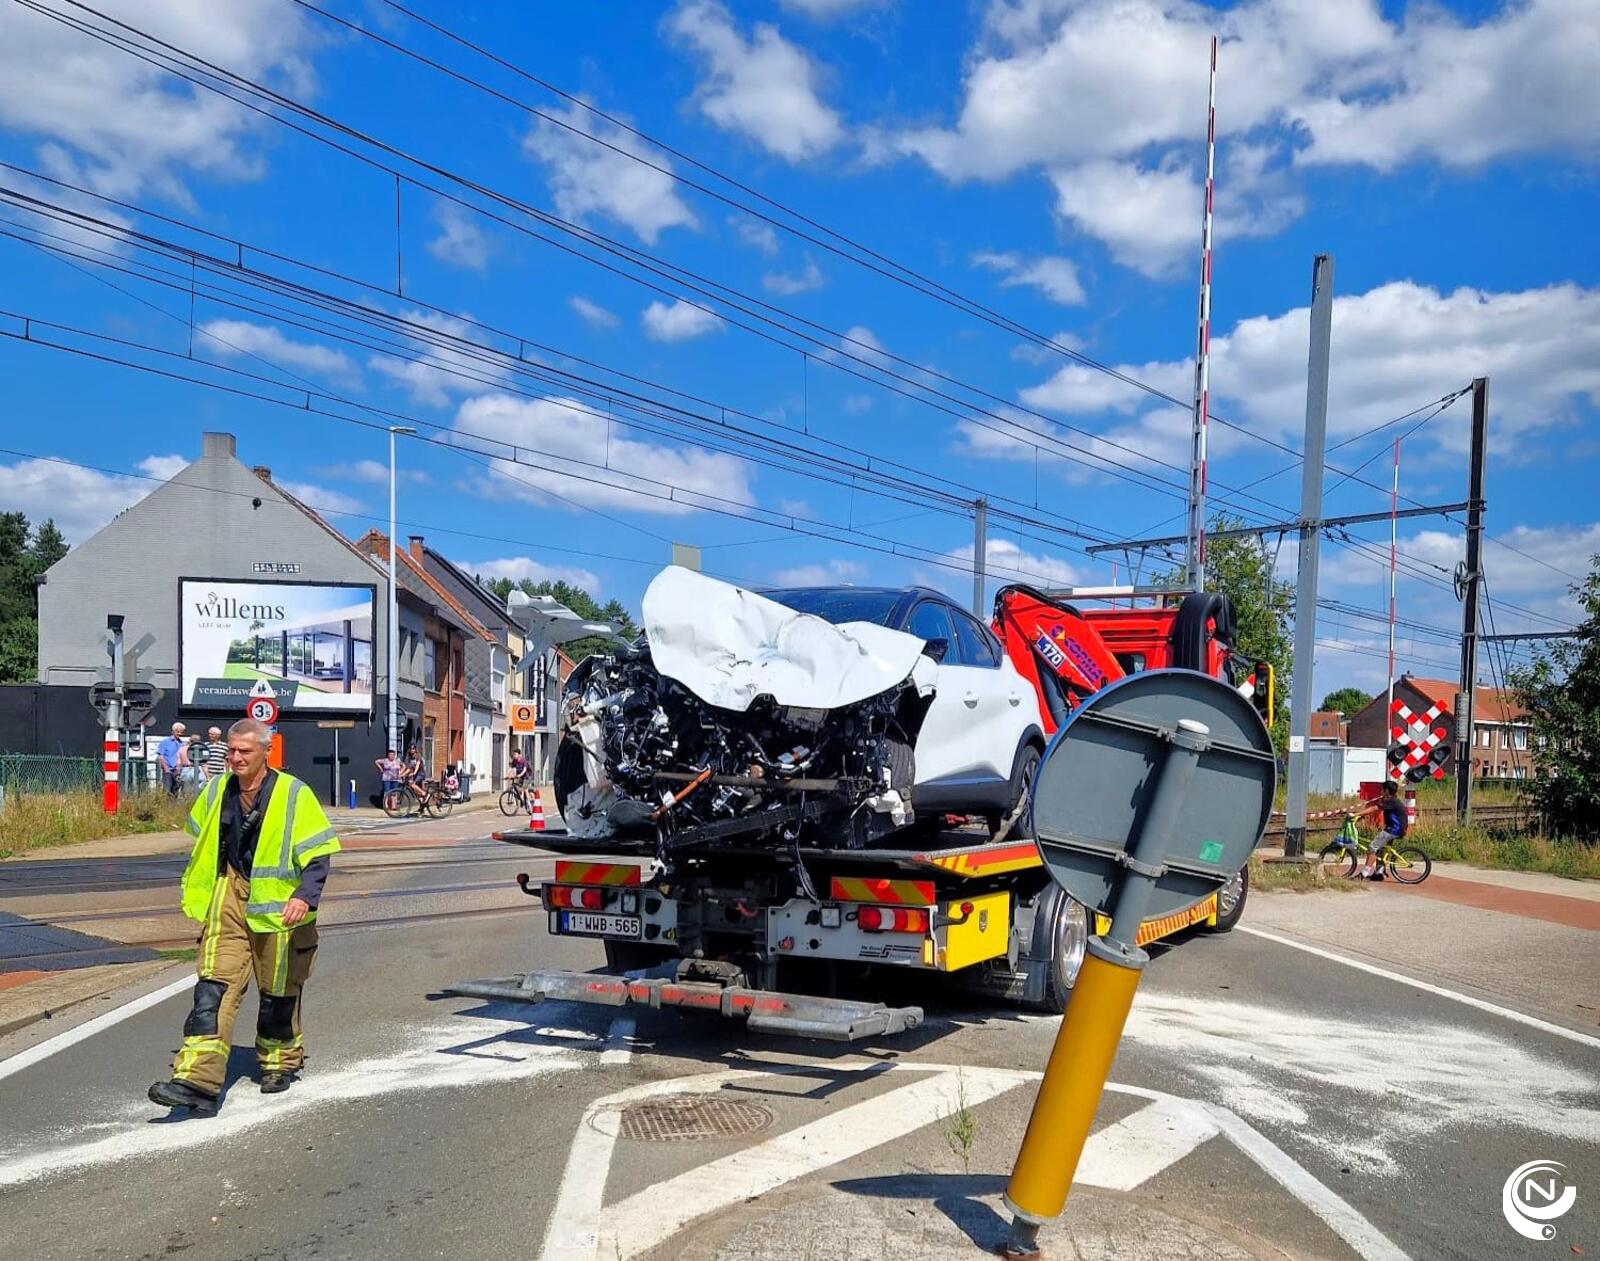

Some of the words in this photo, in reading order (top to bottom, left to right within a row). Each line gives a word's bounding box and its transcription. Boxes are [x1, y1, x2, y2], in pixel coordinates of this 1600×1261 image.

[195, 598, 285, 620] willems
[1042, 642, 1063, 665] 170
[199, 686, 292, 697] verandasws.be
